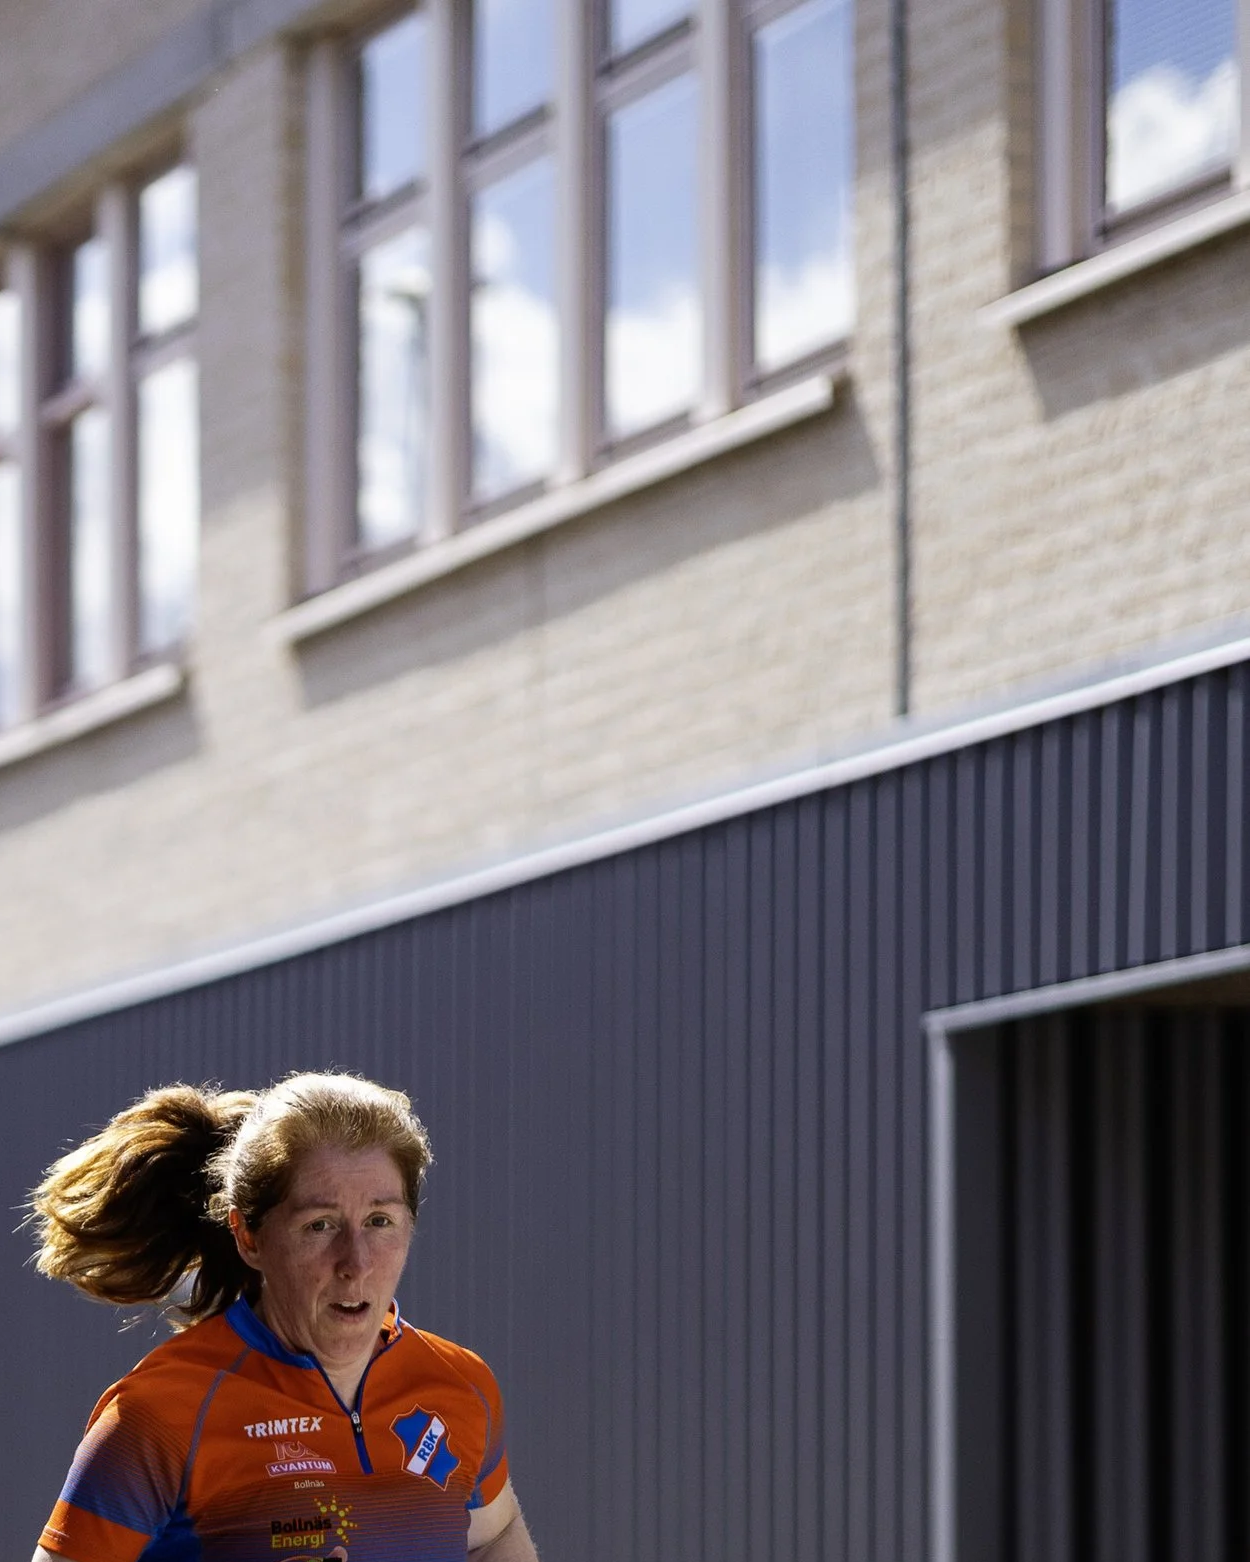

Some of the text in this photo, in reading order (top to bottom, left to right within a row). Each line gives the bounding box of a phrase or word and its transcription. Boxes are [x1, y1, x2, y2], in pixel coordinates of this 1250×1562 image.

[244, 1417, 323, 1437] TRIMTEX
[417, 1428, 438, 1462] RBK
[271, 1461, 332, 1473] KVANTUM
[294, 1480, 325, 1489] Bollnäs
[271, 1517, 332, 1534] Bollnäs
[271, 1531, 326, 1548] Energi
